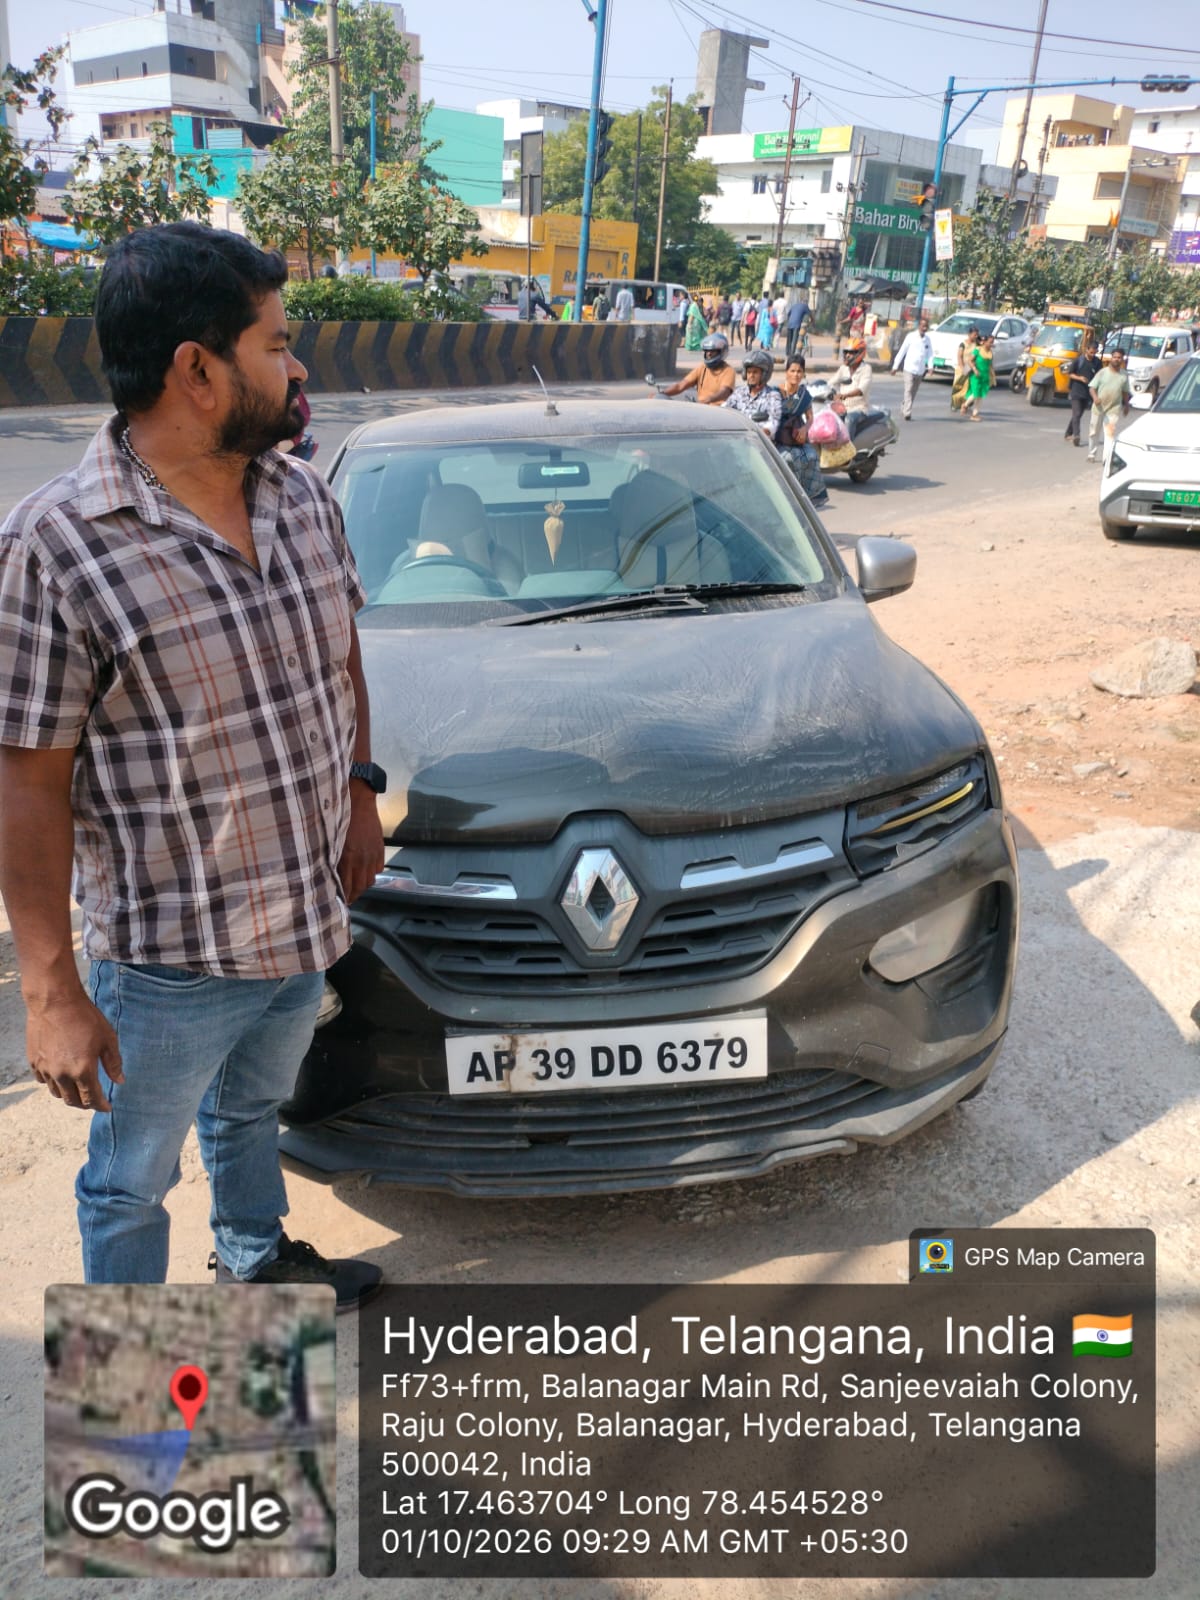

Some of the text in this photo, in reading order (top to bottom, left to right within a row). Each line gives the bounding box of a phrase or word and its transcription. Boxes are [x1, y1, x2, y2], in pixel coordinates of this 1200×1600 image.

[855, 206, 896, 228] Bahar
[466, 1036, 749, 1083] AP 39 DD 6379
